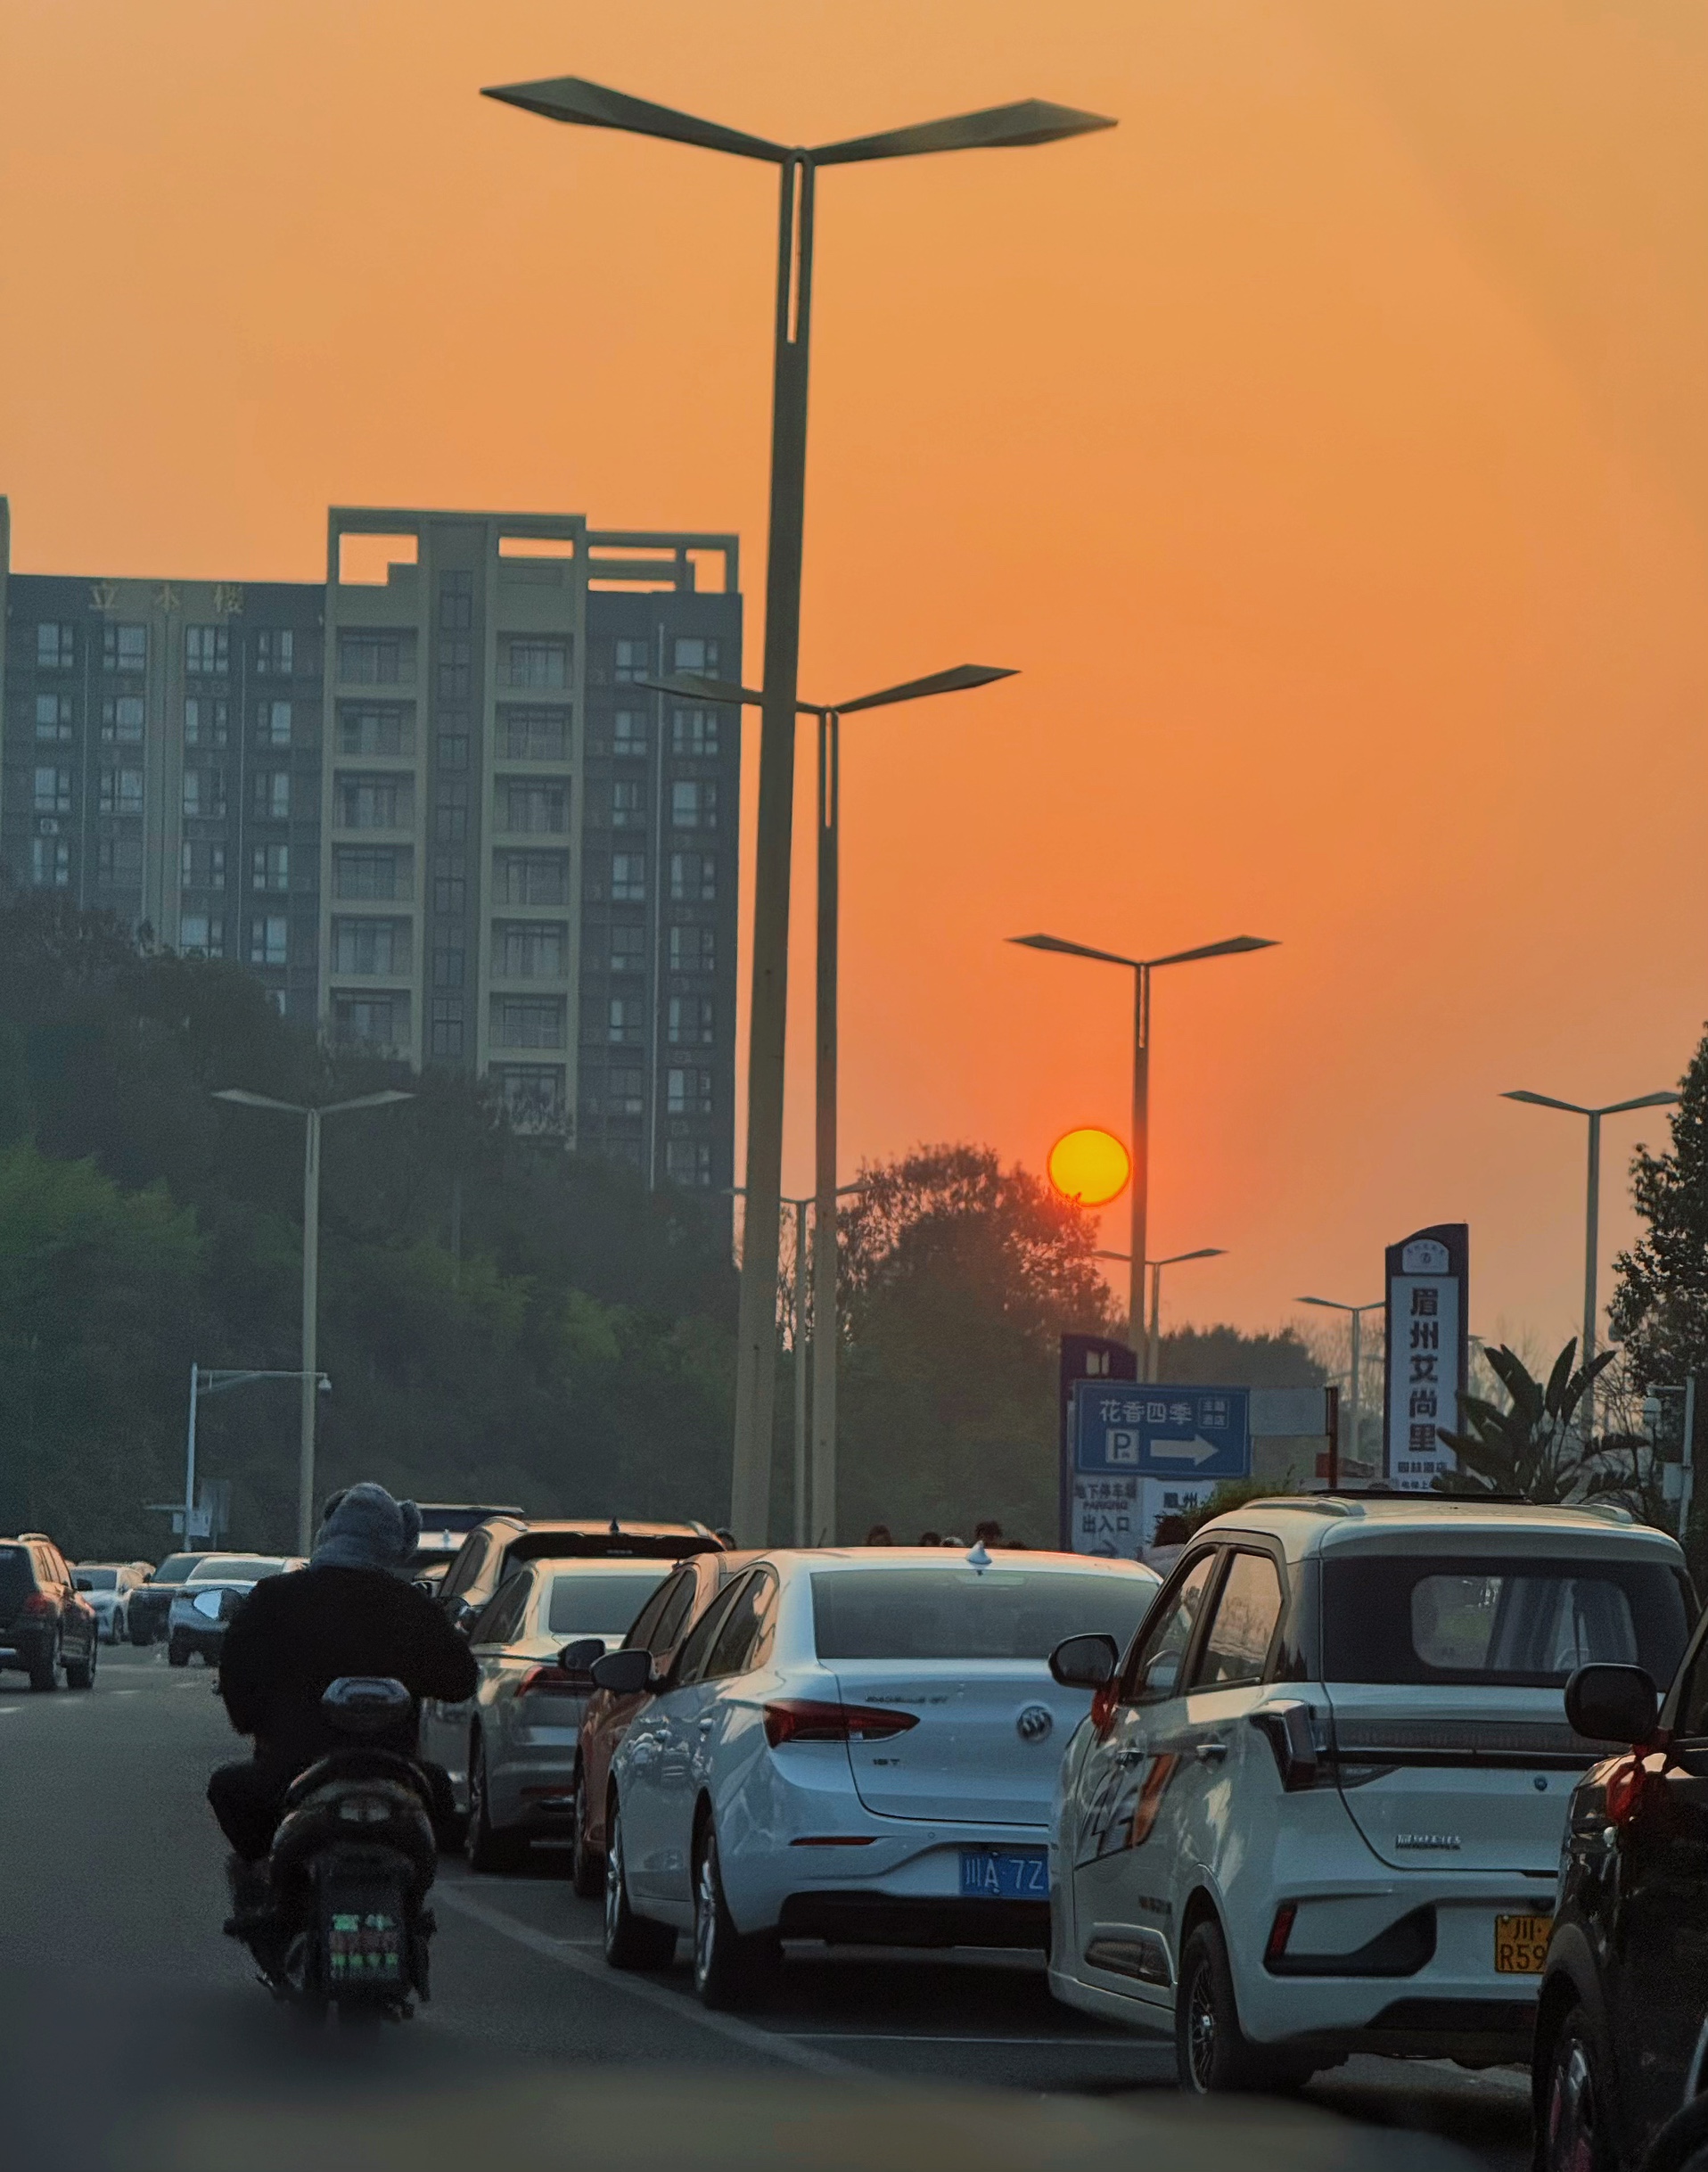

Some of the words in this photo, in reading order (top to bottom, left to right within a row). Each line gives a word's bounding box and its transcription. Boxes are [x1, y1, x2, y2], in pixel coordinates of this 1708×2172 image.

[1408, 1287, 1439, 1452] 眉州艾尚里
[1099, 1398, 1192, 1425] 花香四季
[1113, 1432, 1131, 1460] P
[1082, 1514, 1129, 1534] 出入口
